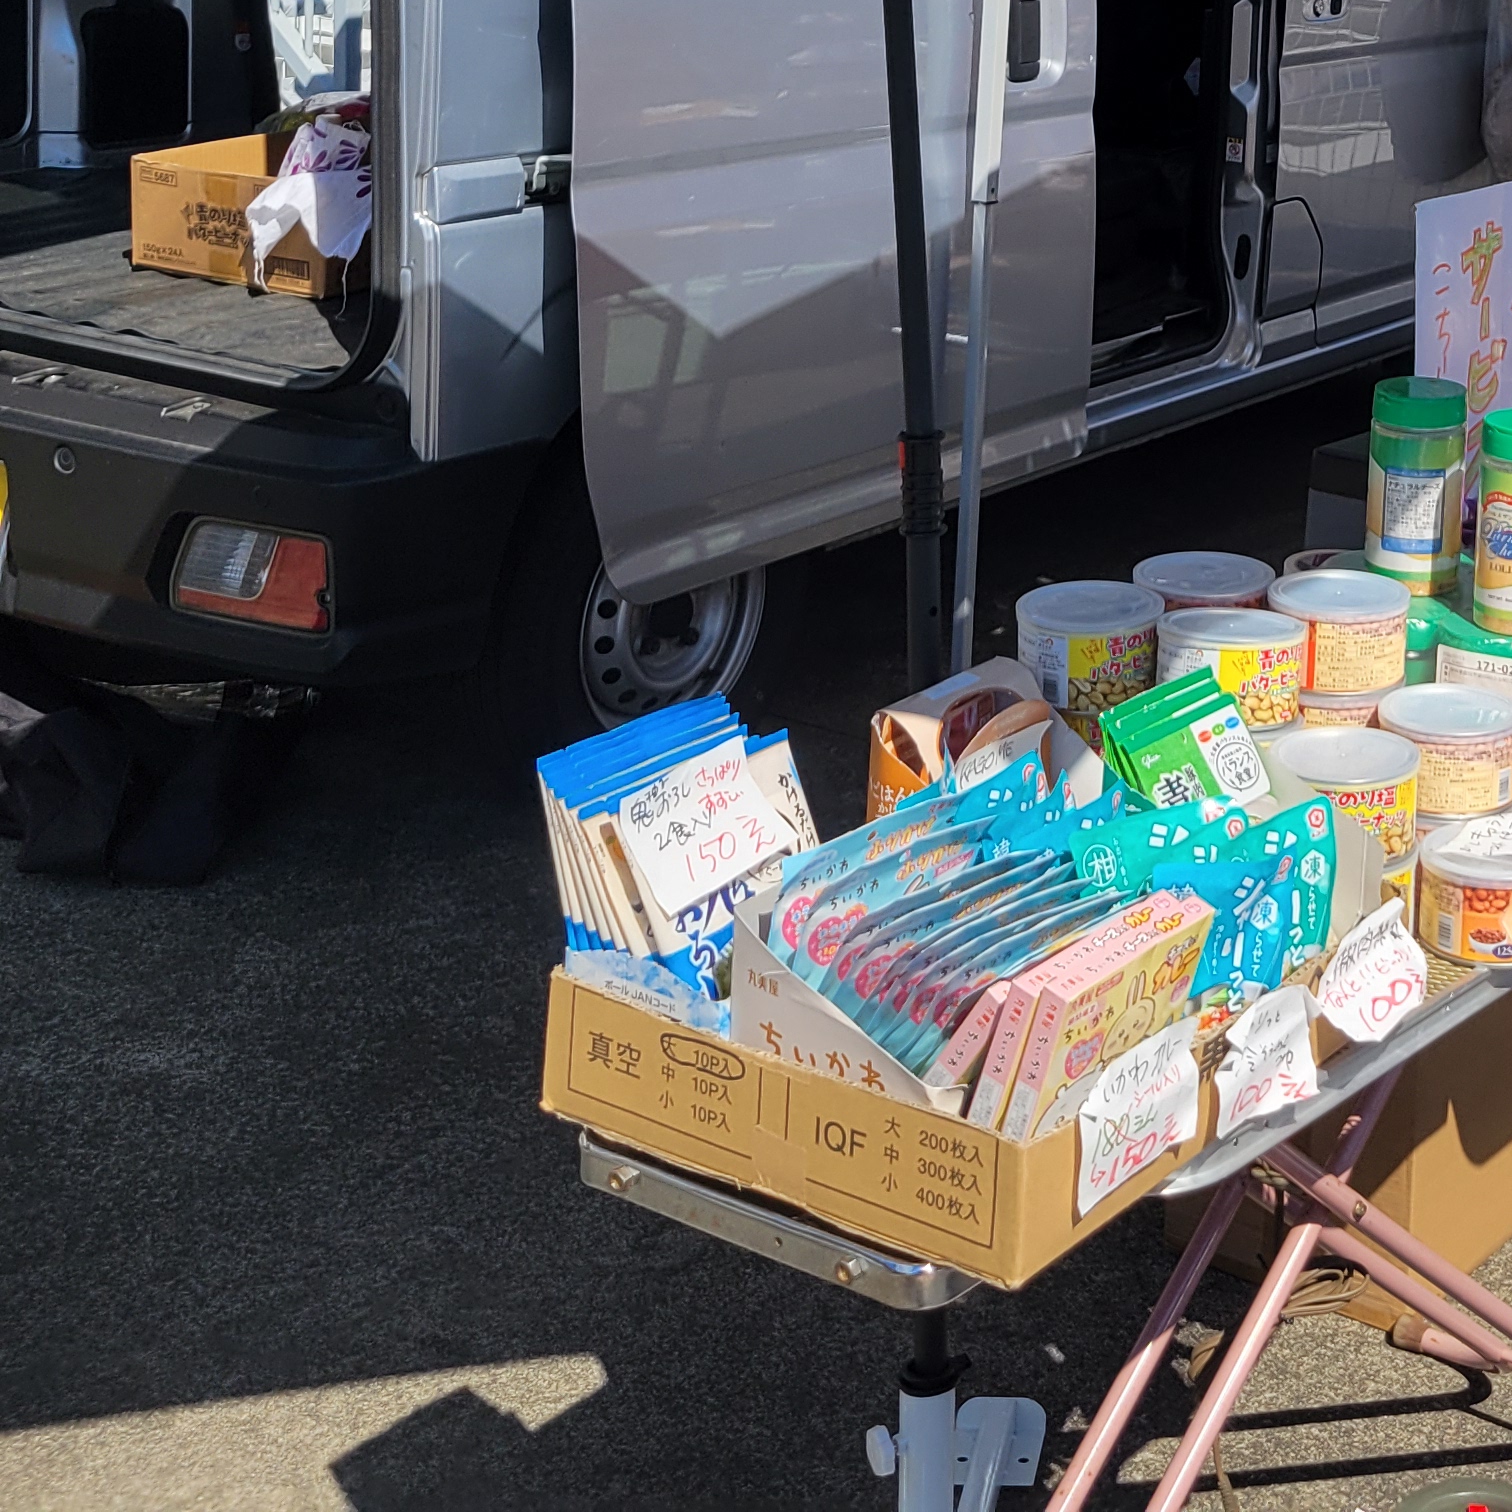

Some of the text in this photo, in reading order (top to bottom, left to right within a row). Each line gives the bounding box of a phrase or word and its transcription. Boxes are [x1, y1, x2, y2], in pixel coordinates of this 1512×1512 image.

[1461, 221, 1507, 438] サービ
[829, 877, 880, 911] ちいかわ
[586, 1030, 642, 1081] 真空
[692, 1049, 732, 1078] 10P入
[759, 1020, 887, 1092] ちいかわ
[661, 1062, 676, 1085] 中
[658, 1090, 675, 1110] 小
[691, 1076, 733, 1106] 10P入
[689, 1104, 731, 1134] 10P入
[883, 1116, 901, 1139] 大
[814, 1116, 867, 1158] IQF
[918, 1130, 985, 1168] 200枚入
[883, 1144, 900, 1166] 中
[881, 1172, 899, 1193] 小
[916, 1158, 983, 1196] 300枚入
[914, 1186, 981, 1225] 400枚入
